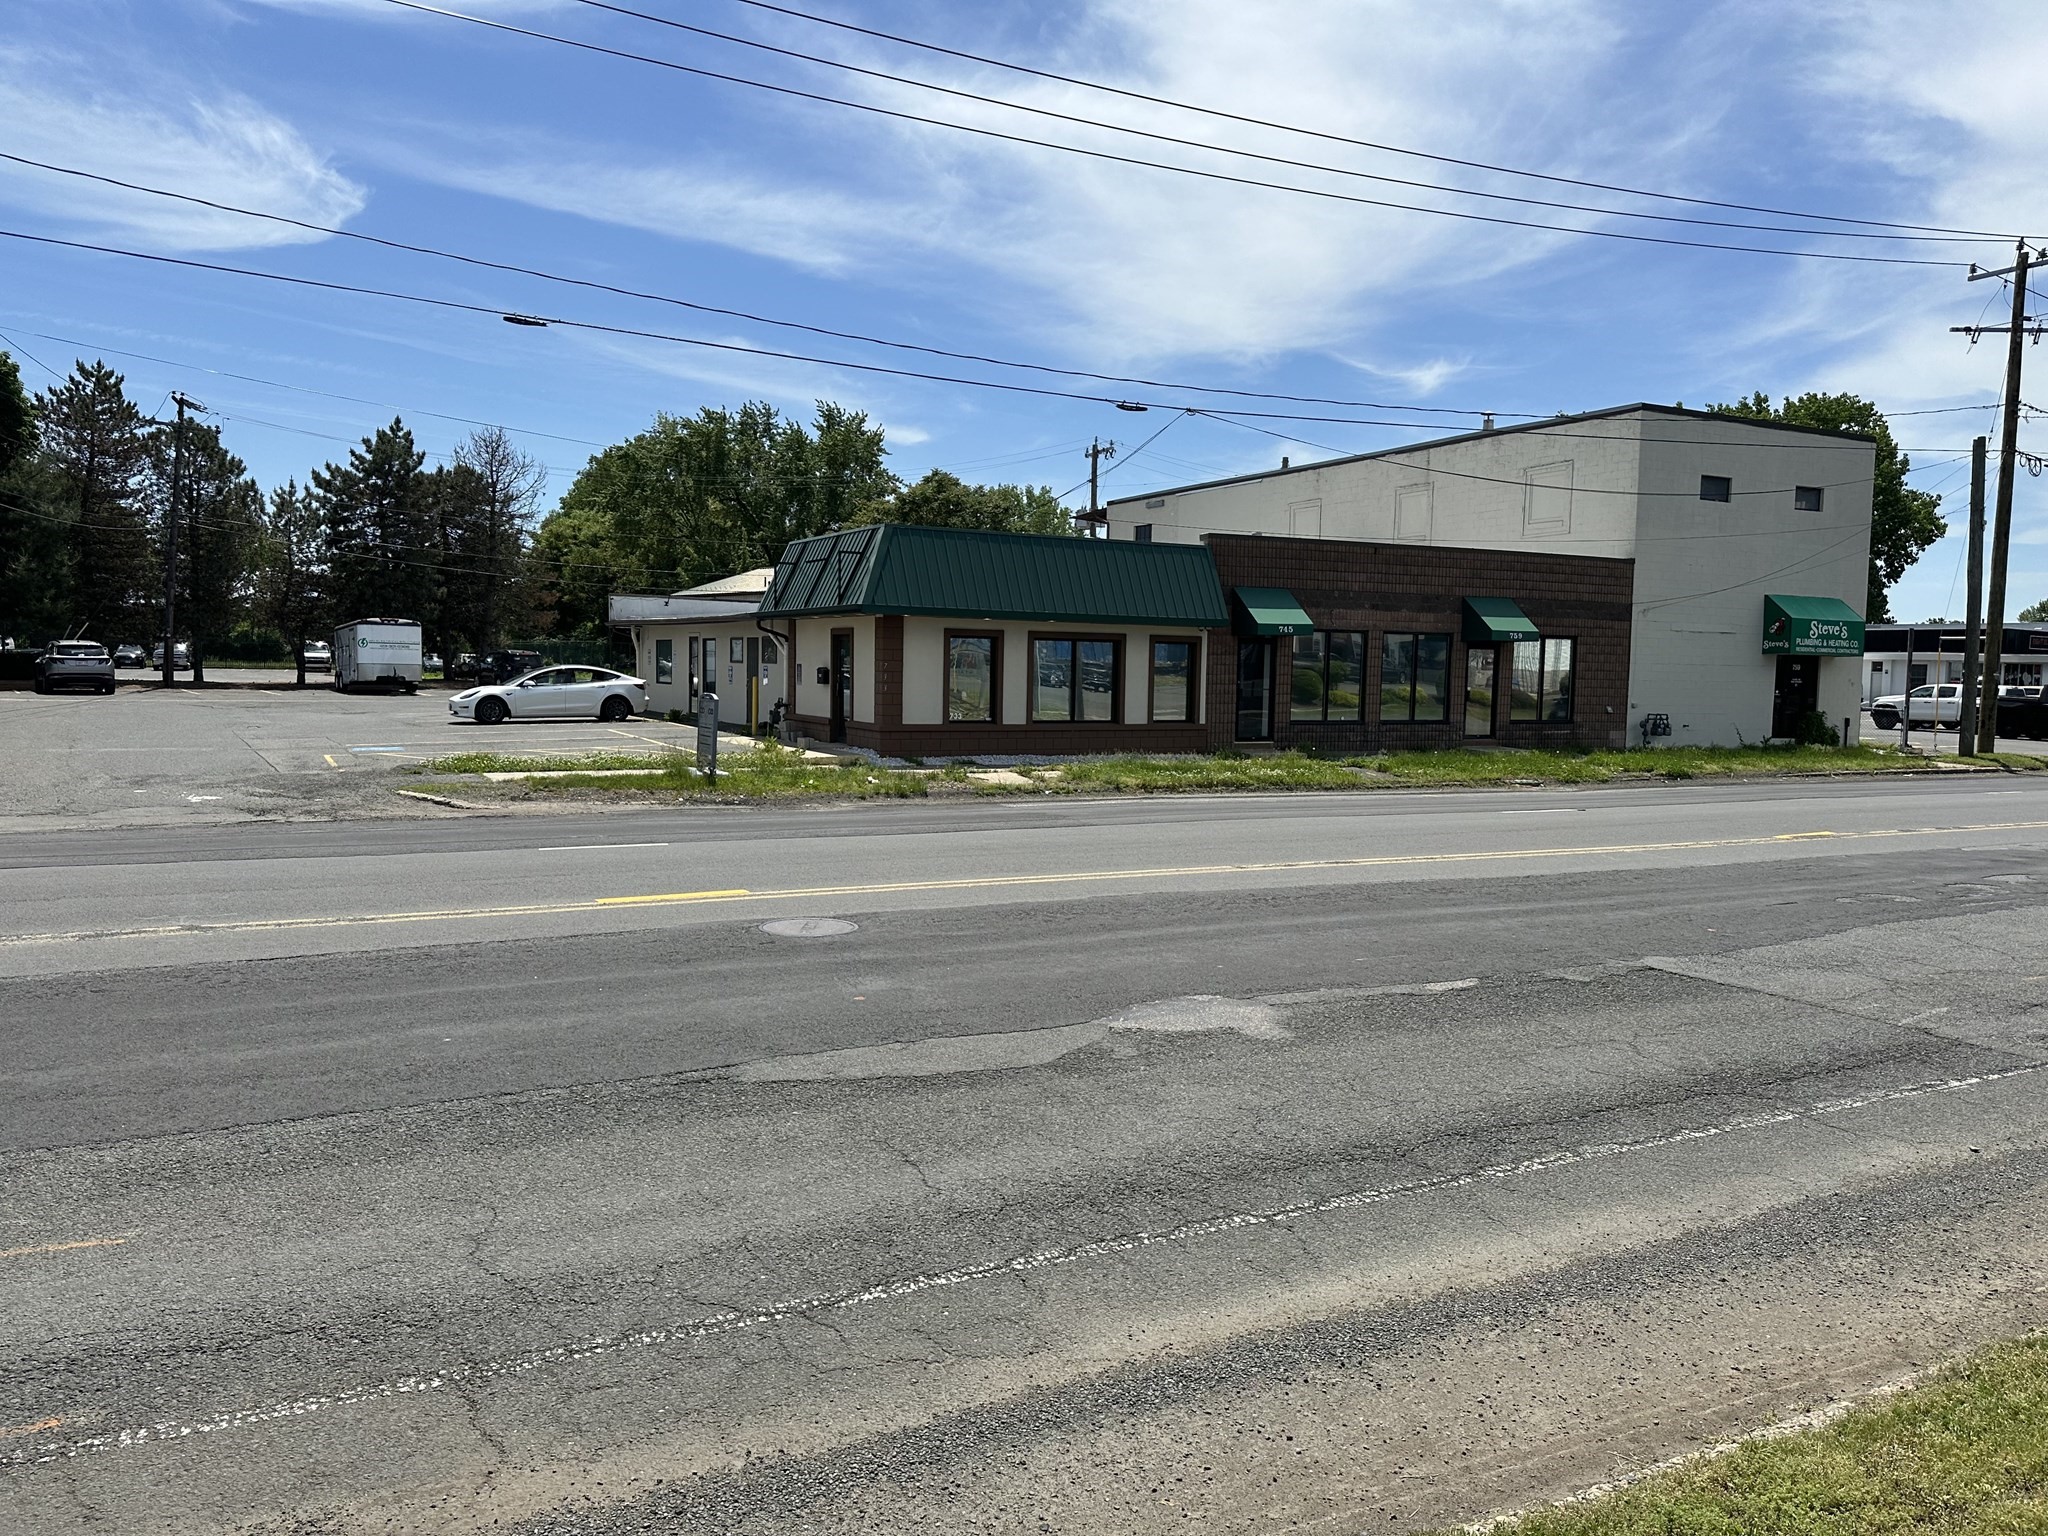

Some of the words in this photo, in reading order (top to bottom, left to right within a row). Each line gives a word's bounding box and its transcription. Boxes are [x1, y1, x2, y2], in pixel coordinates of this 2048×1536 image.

[1278, 625, 1294, 633] 745
[1809, 620, 1848, 639] Steve's
[1509, 632, 1523, 640] 759
[1762, 639, 1790, 650] Steve's
[1795, 637, 1822, 646] PLUMBING
[1823, 639, 1828, 647] &
[1828, 639, 1849, 648] HEATING
[948, 712, 962, 720] 733
